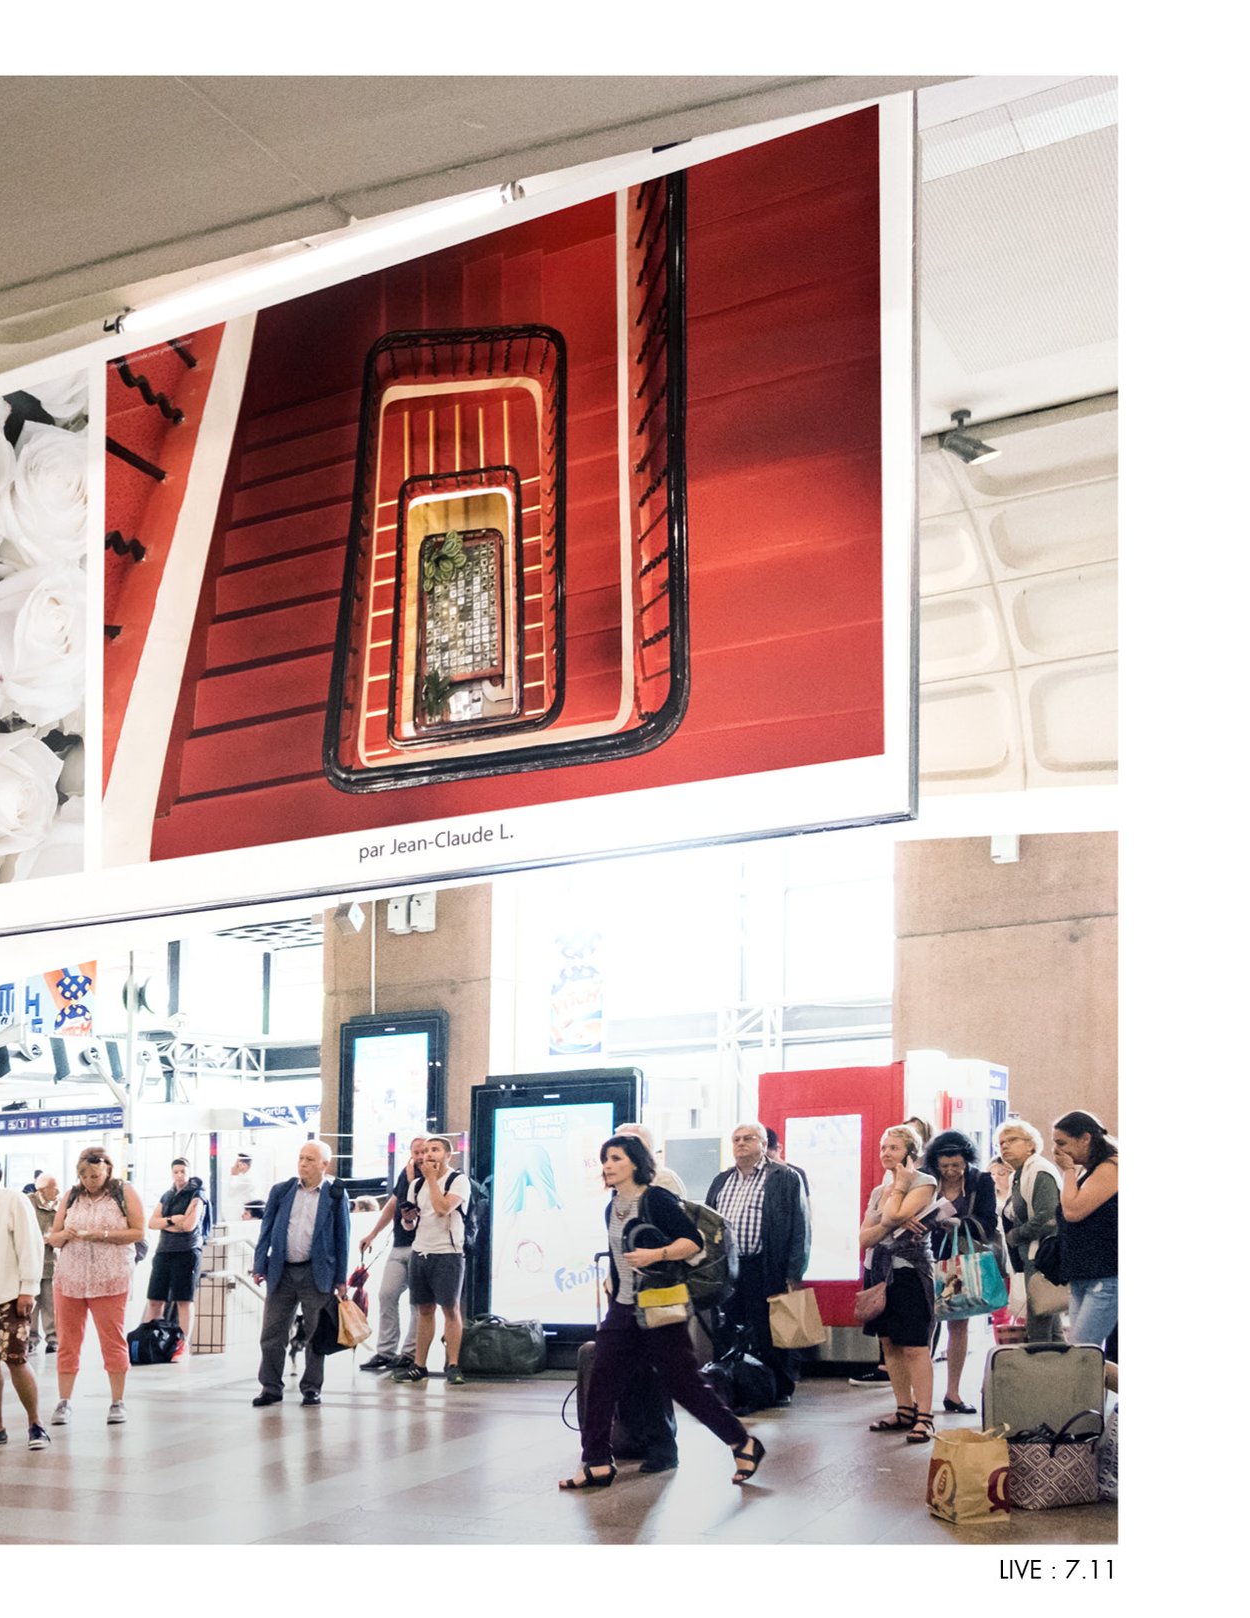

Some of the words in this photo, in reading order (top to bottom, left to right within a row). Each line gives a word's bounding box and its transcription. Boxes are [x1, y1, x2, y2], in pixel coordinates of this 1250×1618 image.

[359, 846, 385, 863] par
[390, 826, 493, 855] Jean-Claude
[500, 824, 514, 840] L.
